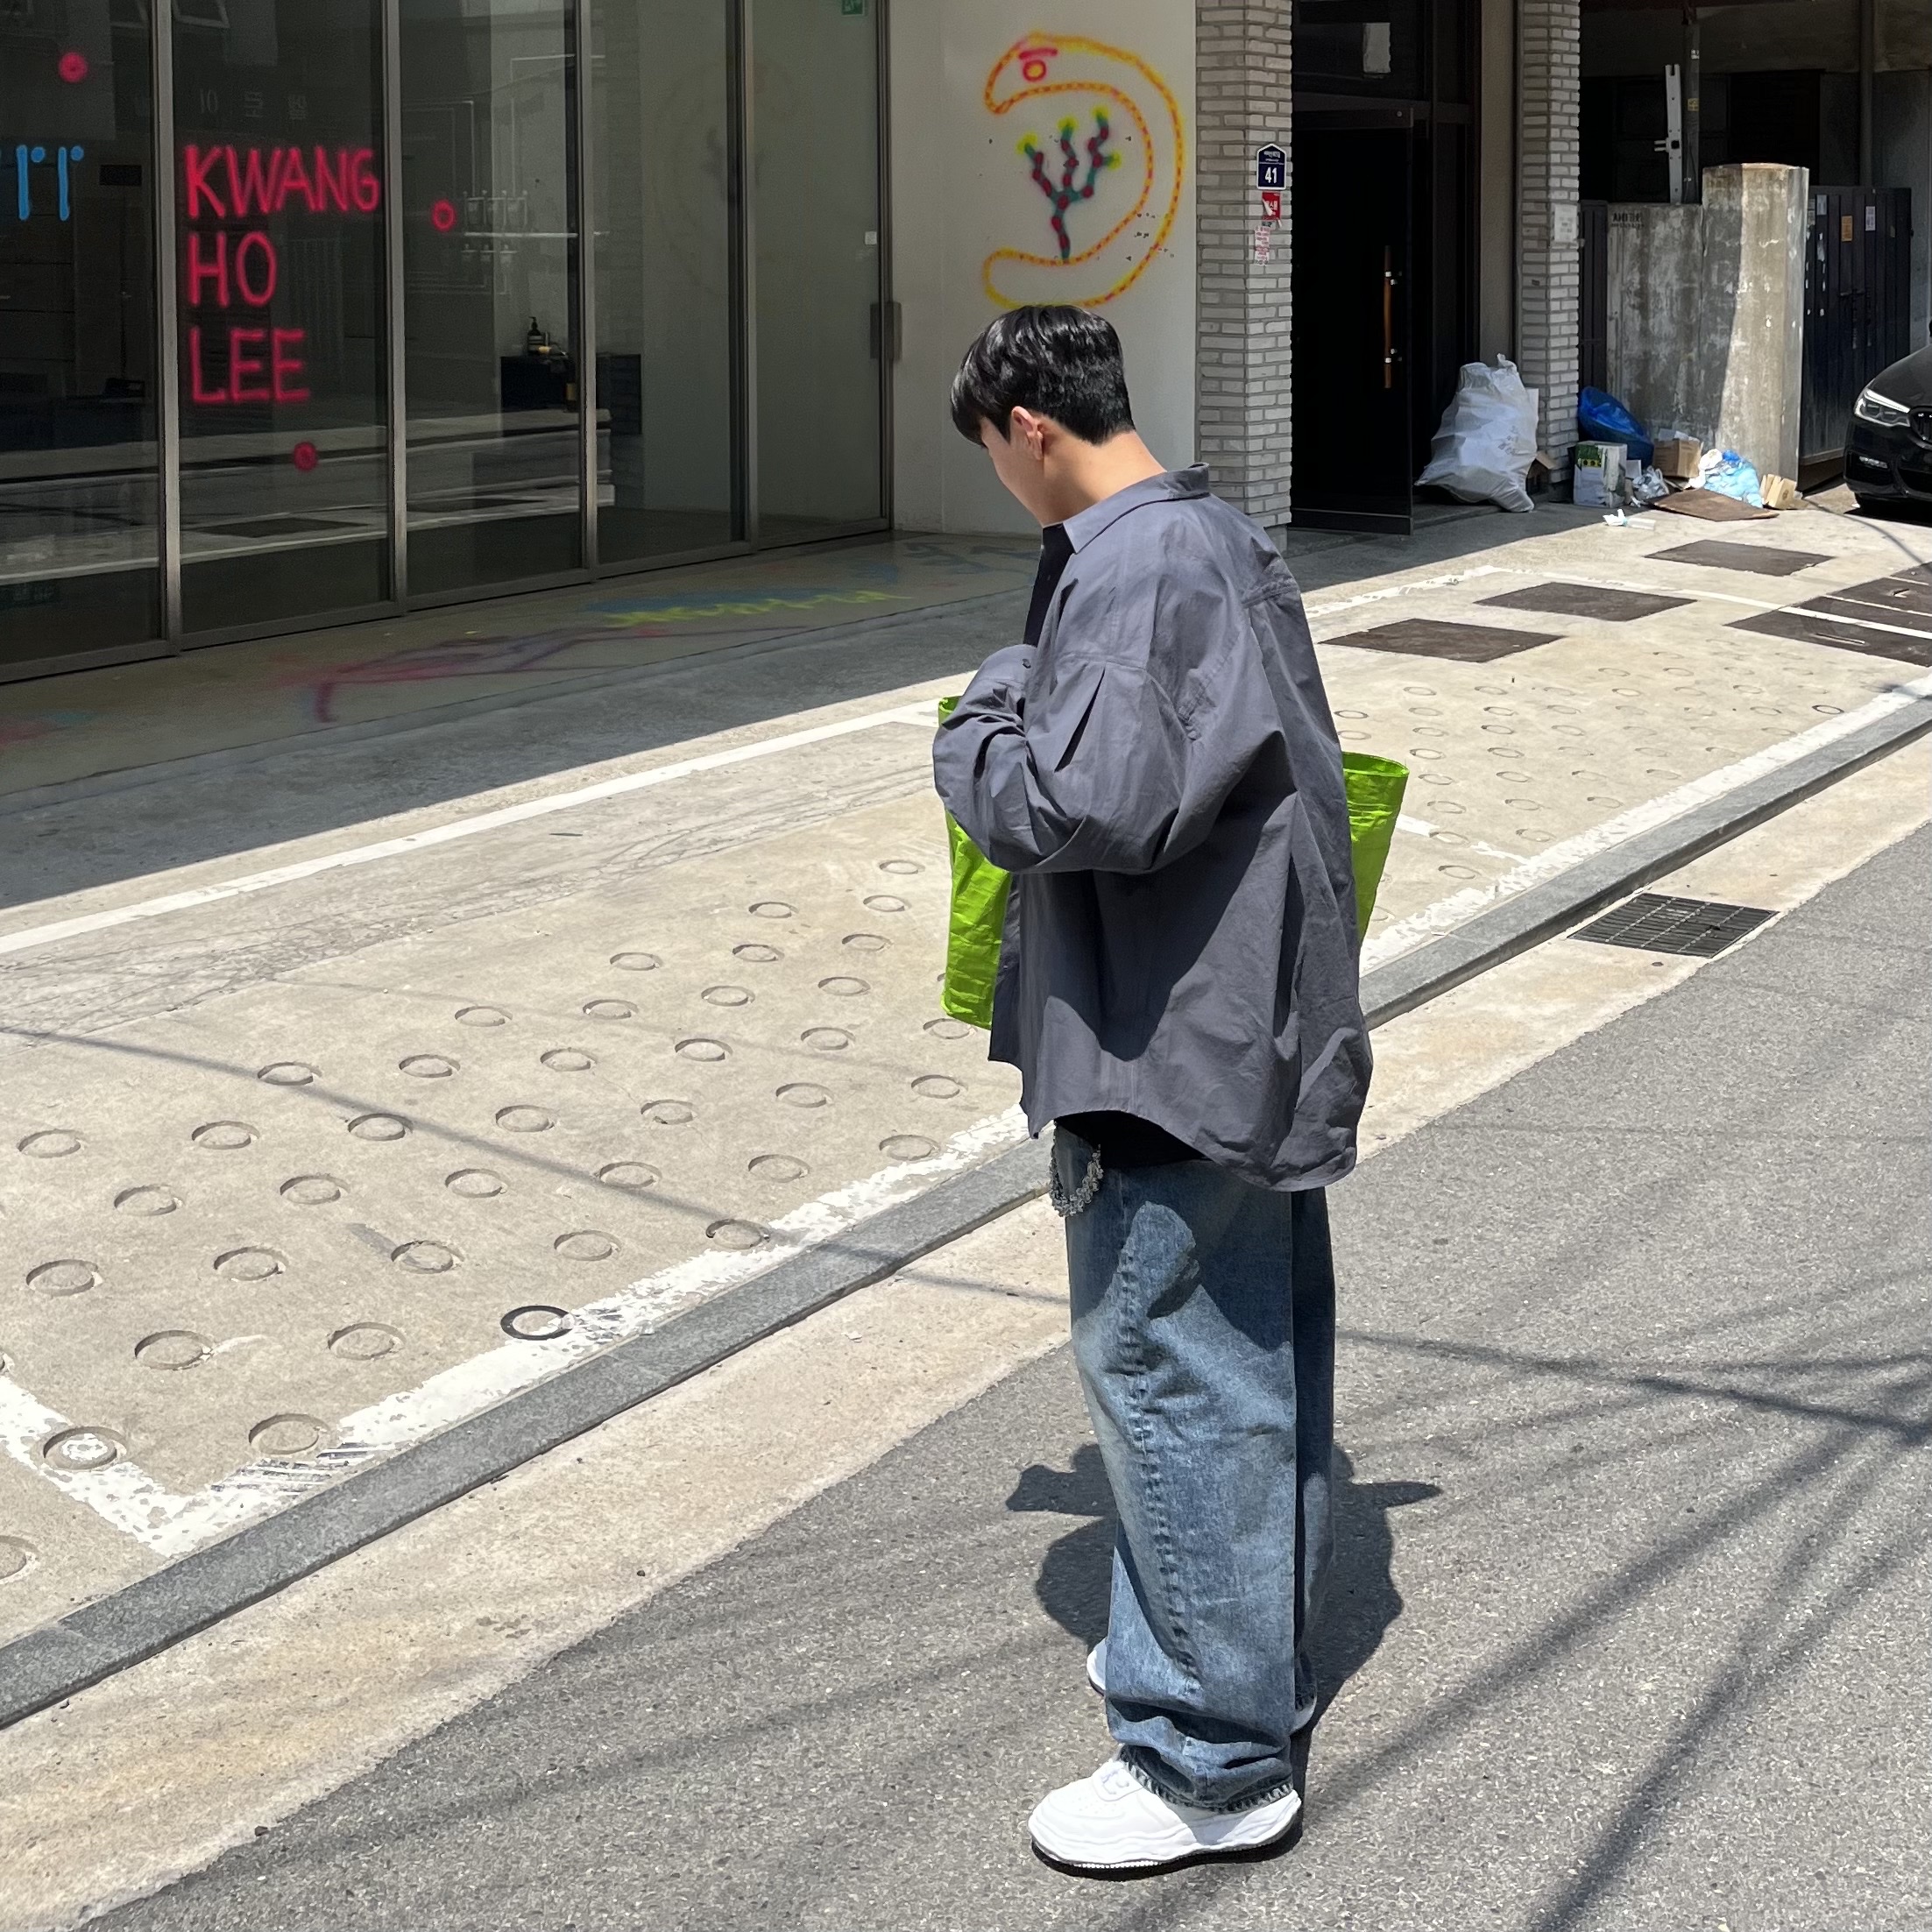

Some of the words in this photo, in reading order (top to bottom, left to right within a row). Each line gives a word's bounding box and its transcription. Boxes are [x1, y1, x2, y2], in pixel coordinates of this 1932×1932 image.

[184, 144, 380, 217] KWANG
[1265, 166, 1277, 184] 41
[187, 230, 277, 307] HO
[188, 326, 310, 405] LEE
